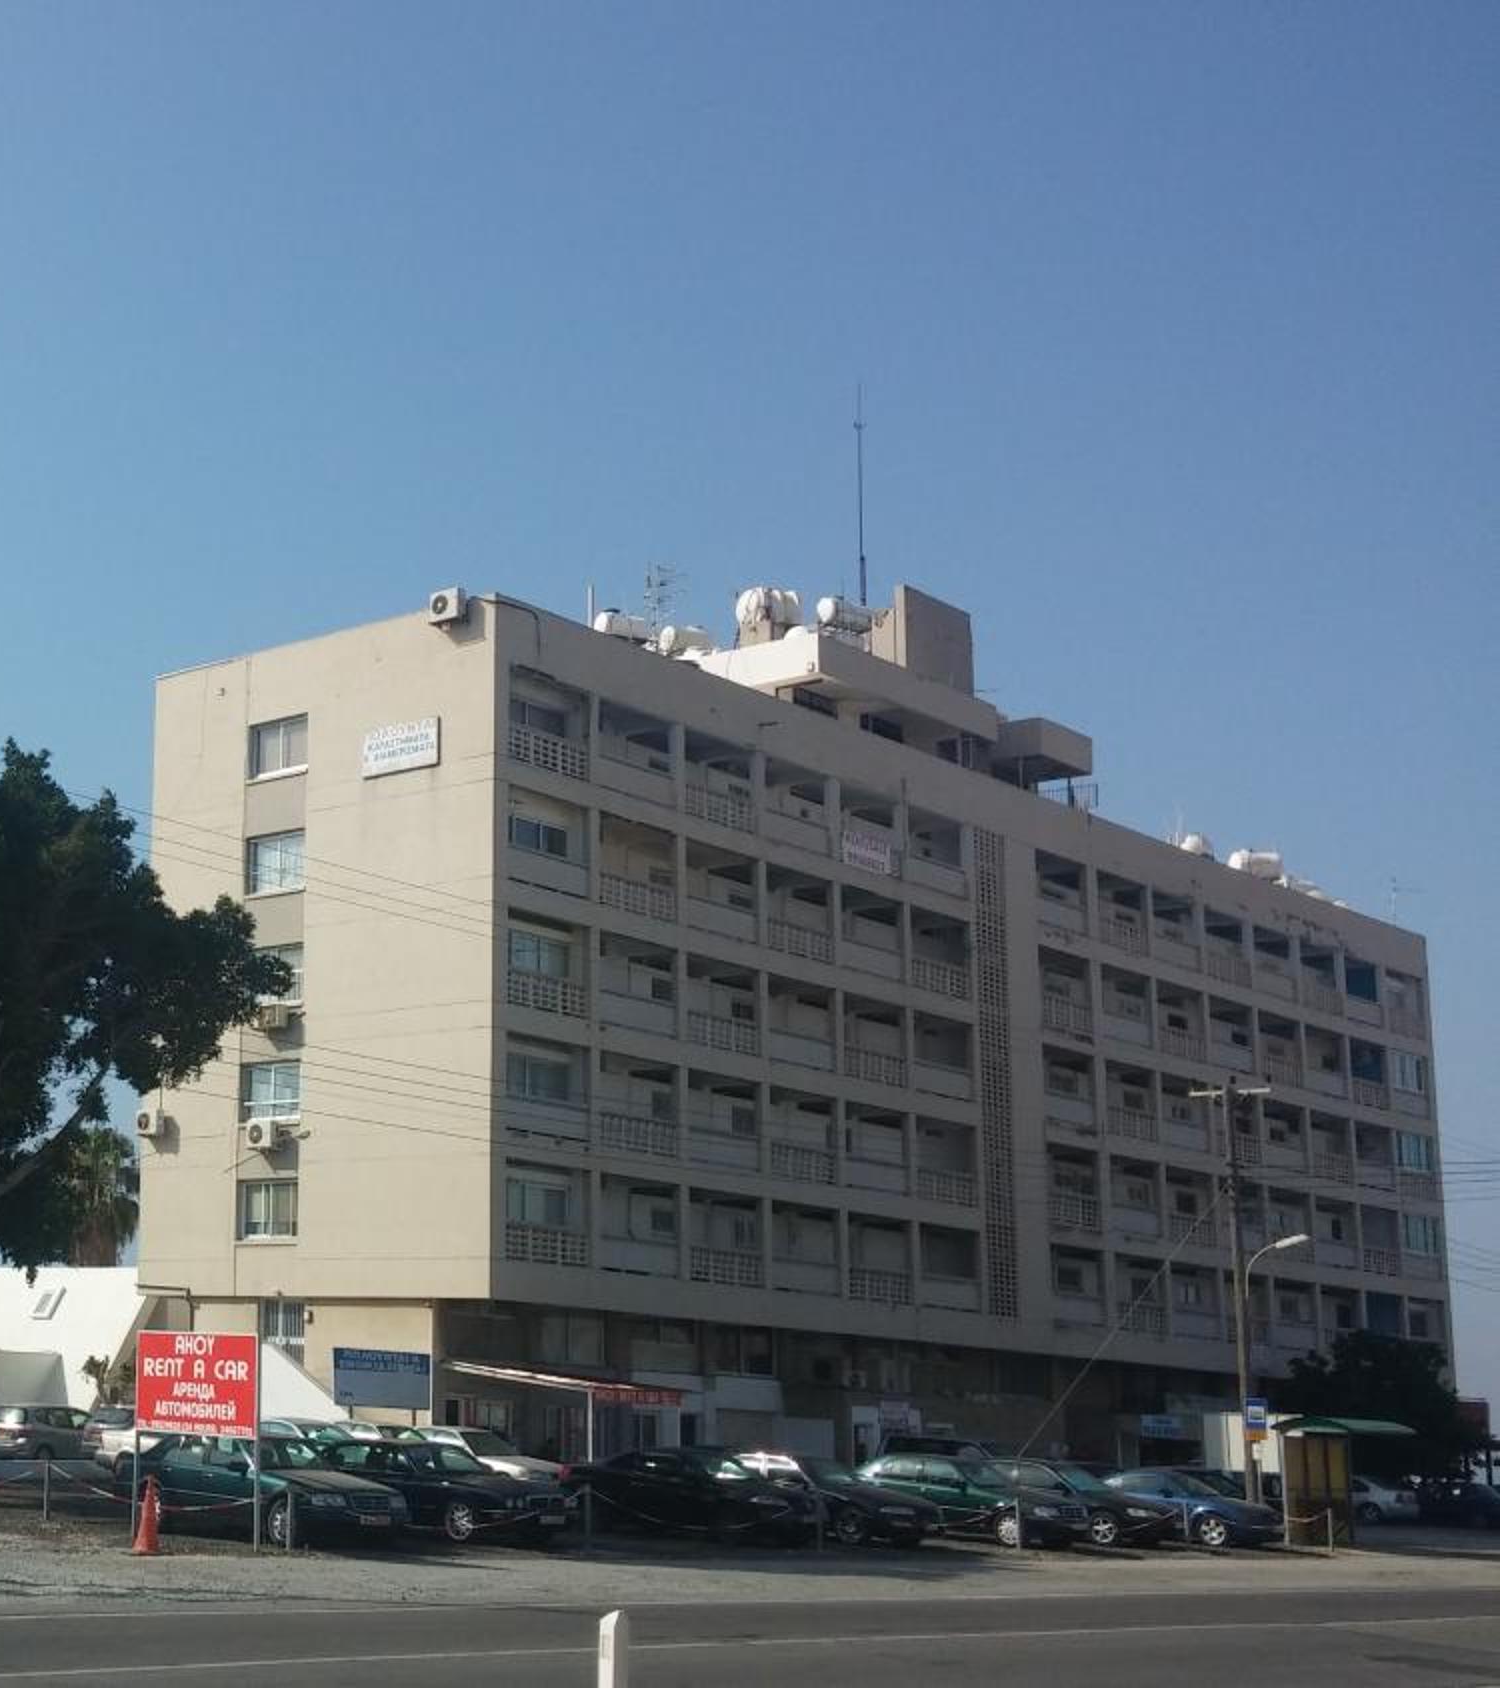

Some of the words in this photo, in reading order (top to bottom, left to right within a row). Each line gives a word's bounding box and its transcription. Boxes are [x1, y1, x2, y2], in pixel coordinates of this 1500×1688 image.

[175, 1335, 215, 1356] AHOY
[143, 1358, 185, 1378] RENT
[193, 1359, 205, 1379] A
[214, 1360, 249, 1381] CAR
[172, 1381, 216, 1402] АРЕНДА
[154, 1400, 237, 1420] АВТОМОБИЛЕЙ
